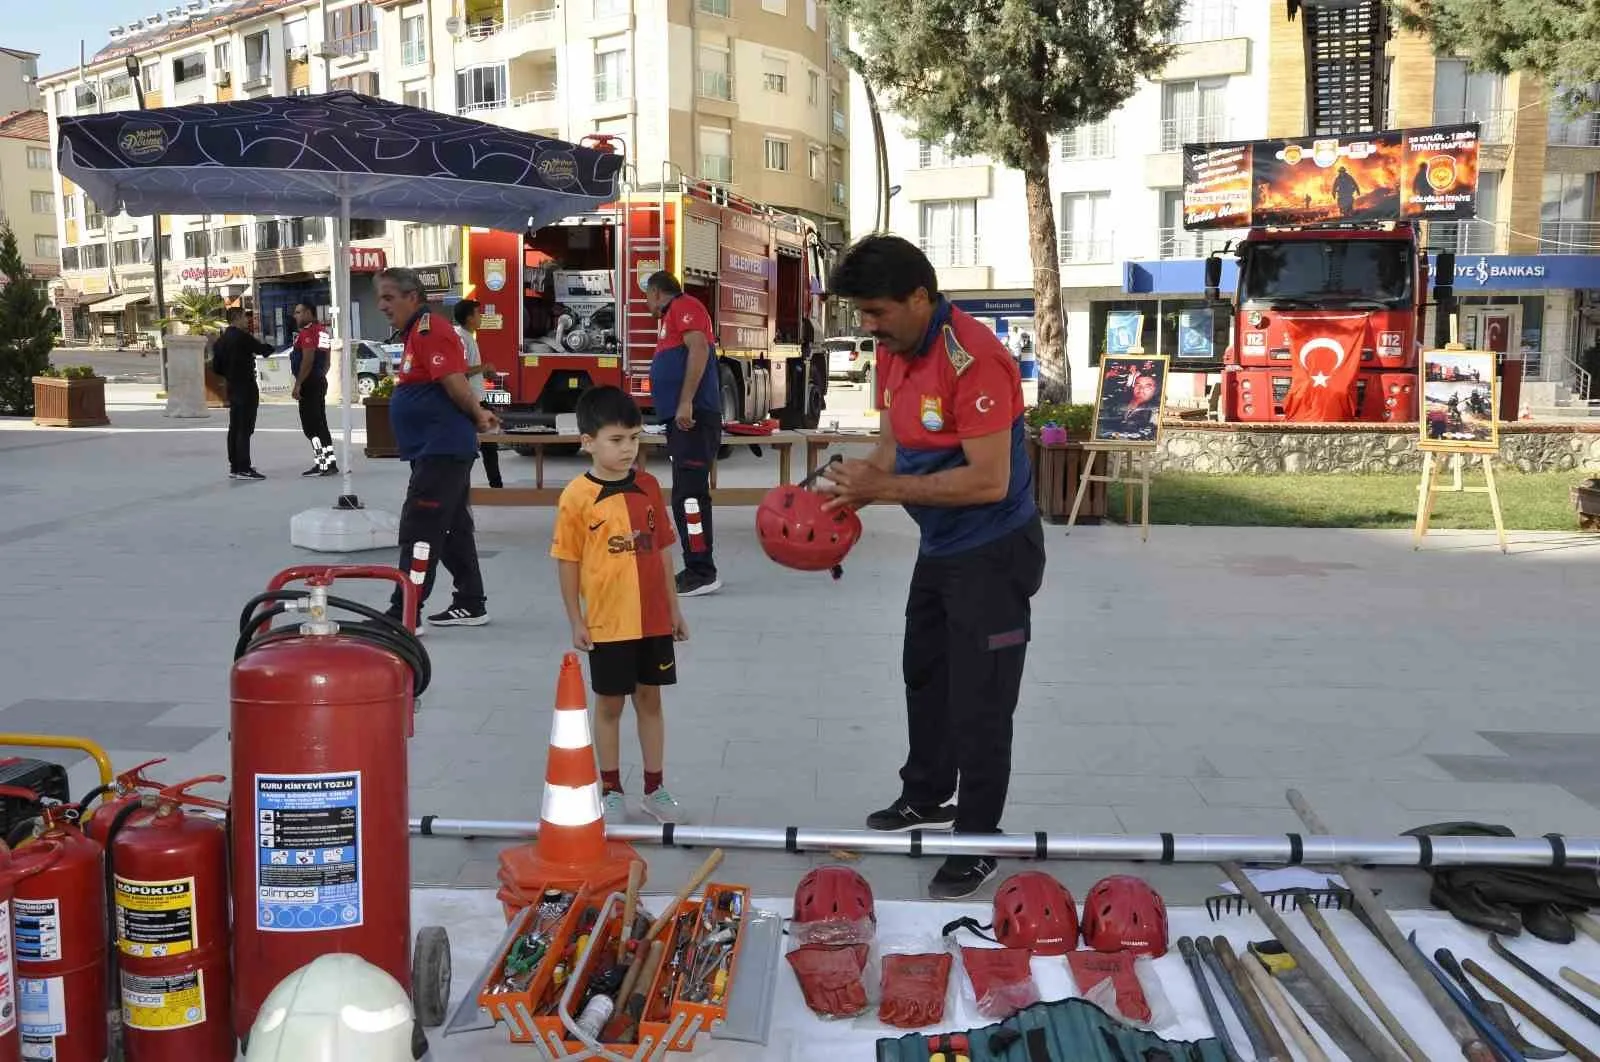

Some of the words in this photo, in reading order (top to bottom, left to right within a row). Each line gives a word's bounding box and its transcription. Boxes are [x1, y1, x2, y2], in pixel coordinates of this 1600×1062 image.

[1490, 265, 1545, 277] BANKASI
[1246, 334, 1264, 346] 112
[1381, 334, 1401, 346] 112
[260, 782, 283, 790] KURU
[284, 780, 322, 790] KİMYEVİ
[323, 780, 353, 789] TOZLU
